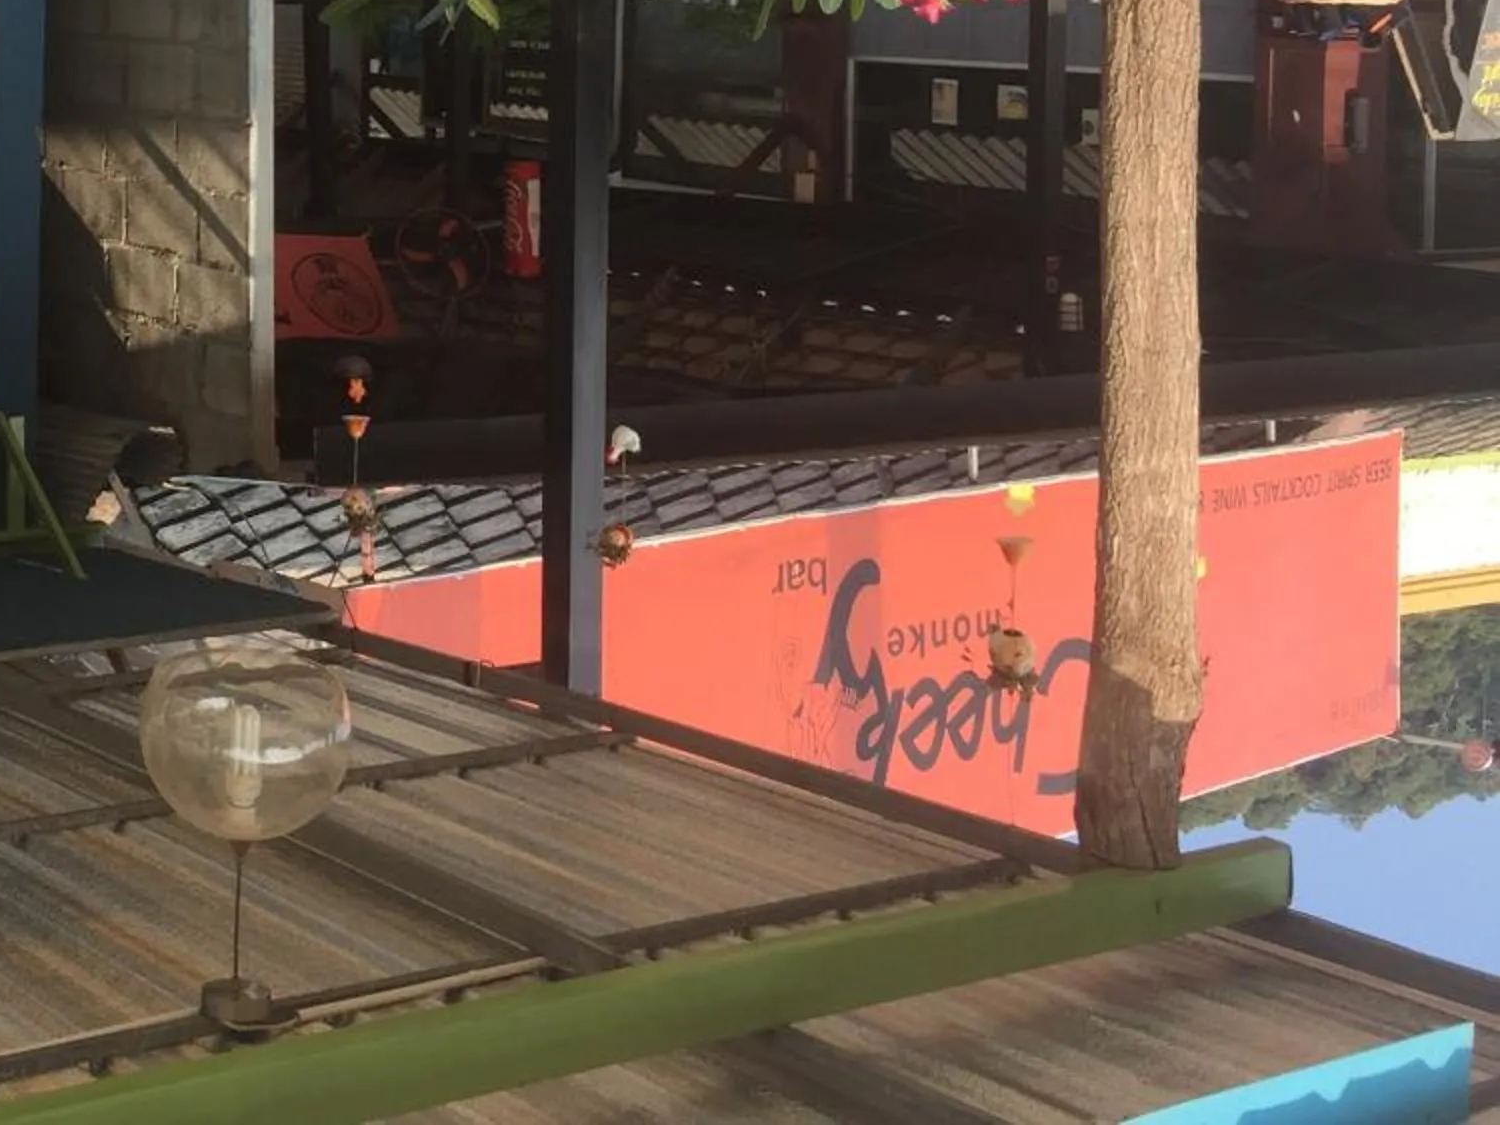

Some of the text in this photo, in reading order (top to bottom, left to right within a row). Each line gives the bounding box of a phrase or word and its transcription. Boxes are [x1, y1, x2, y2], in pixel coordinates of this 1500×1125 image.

[1326, 465, 1361, 493] SPIRIT
[1365, 458, 1392, 484] BEER
[1212, 485, 1247, 513] WINE
[1252, 473, 1321, 506] COCKTAILS
[771, 557, 829, 595] bar
[813, 559, 1092, 795] Cheeky
